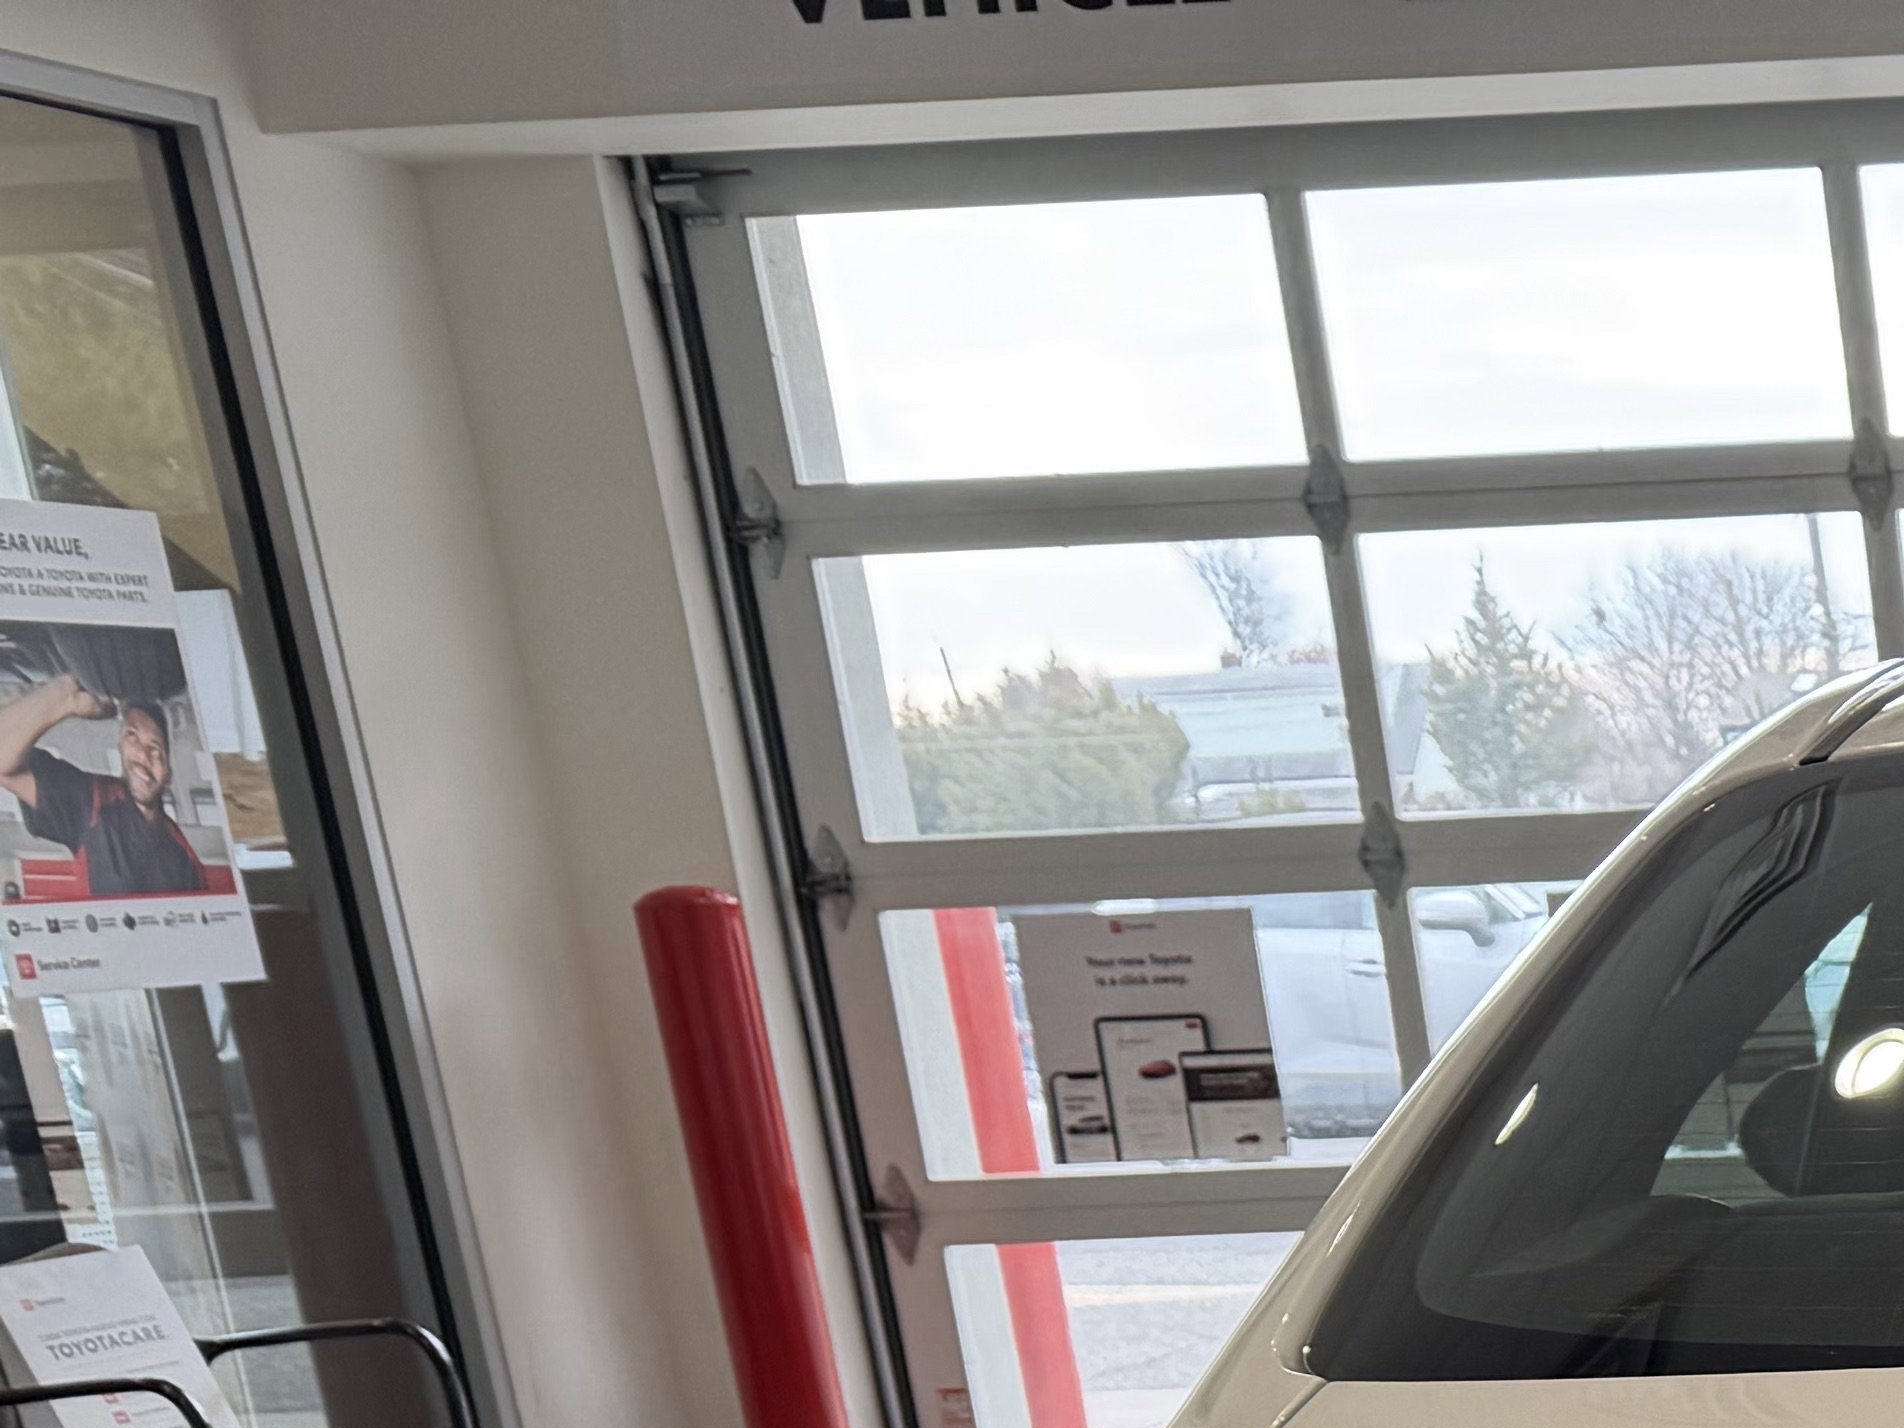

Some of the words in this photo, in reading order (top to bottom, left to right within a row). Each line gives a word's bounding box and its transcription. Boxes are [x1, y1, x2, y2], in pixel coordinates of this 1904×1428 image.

[31, 535, 90, 560] VALUE,
[44, 567, 84, 583] TOYOTA
[114, 572, 149, 587] EXPERT
[28, 584, 75, 598] GENUINE
[76, 587, 114, 601] TOYOTA
[45, 1324, 168, 1361] TOYOTACARE
